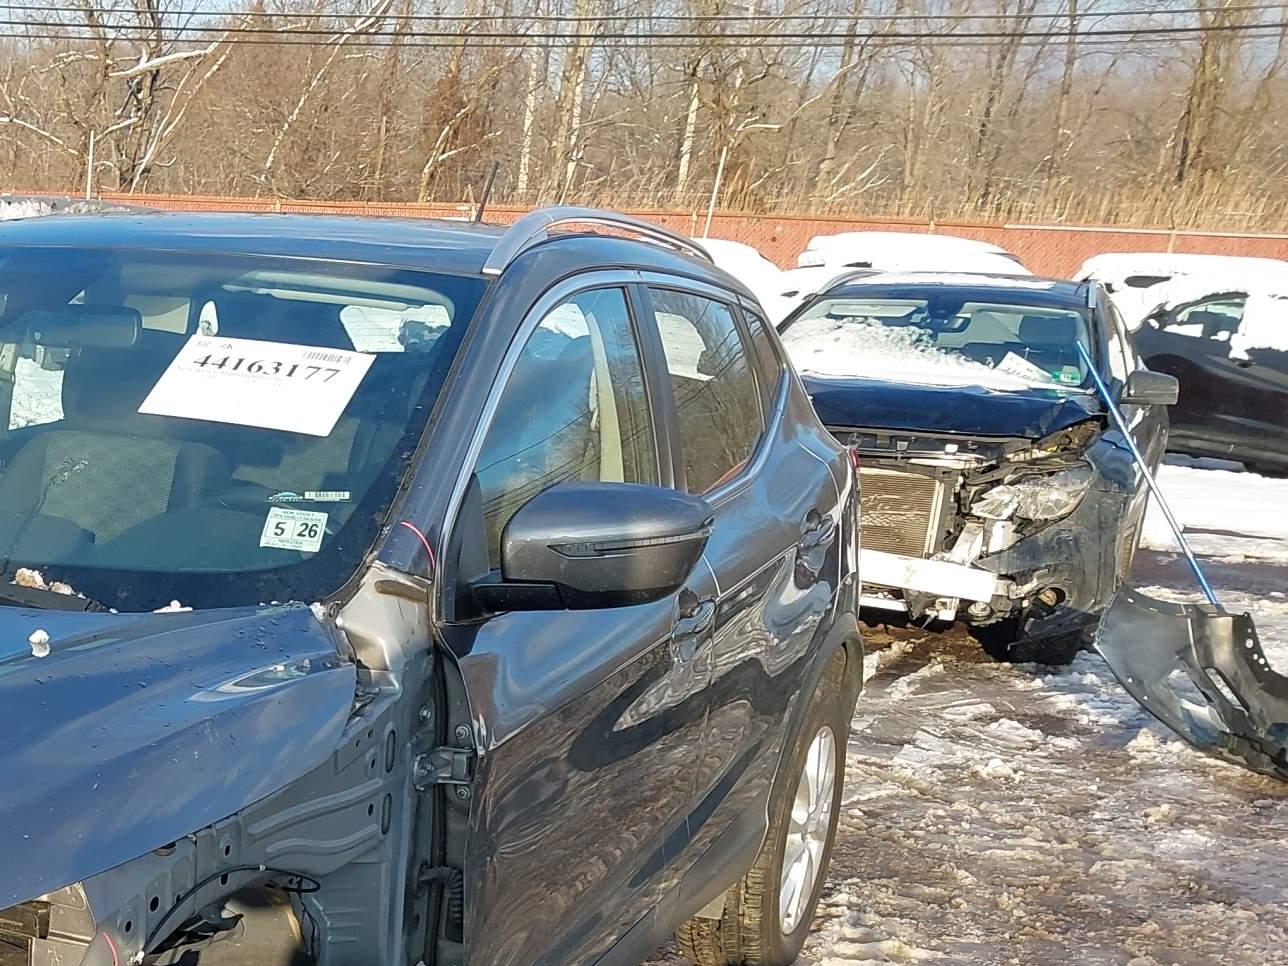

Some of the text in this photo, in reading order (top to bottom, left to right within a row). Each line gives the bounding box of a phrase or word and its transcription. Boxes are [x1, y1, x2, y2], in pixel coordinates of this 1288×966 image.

[193, 354, 341, 383] 44163177
[274, 522, 319, 538] 5 26
